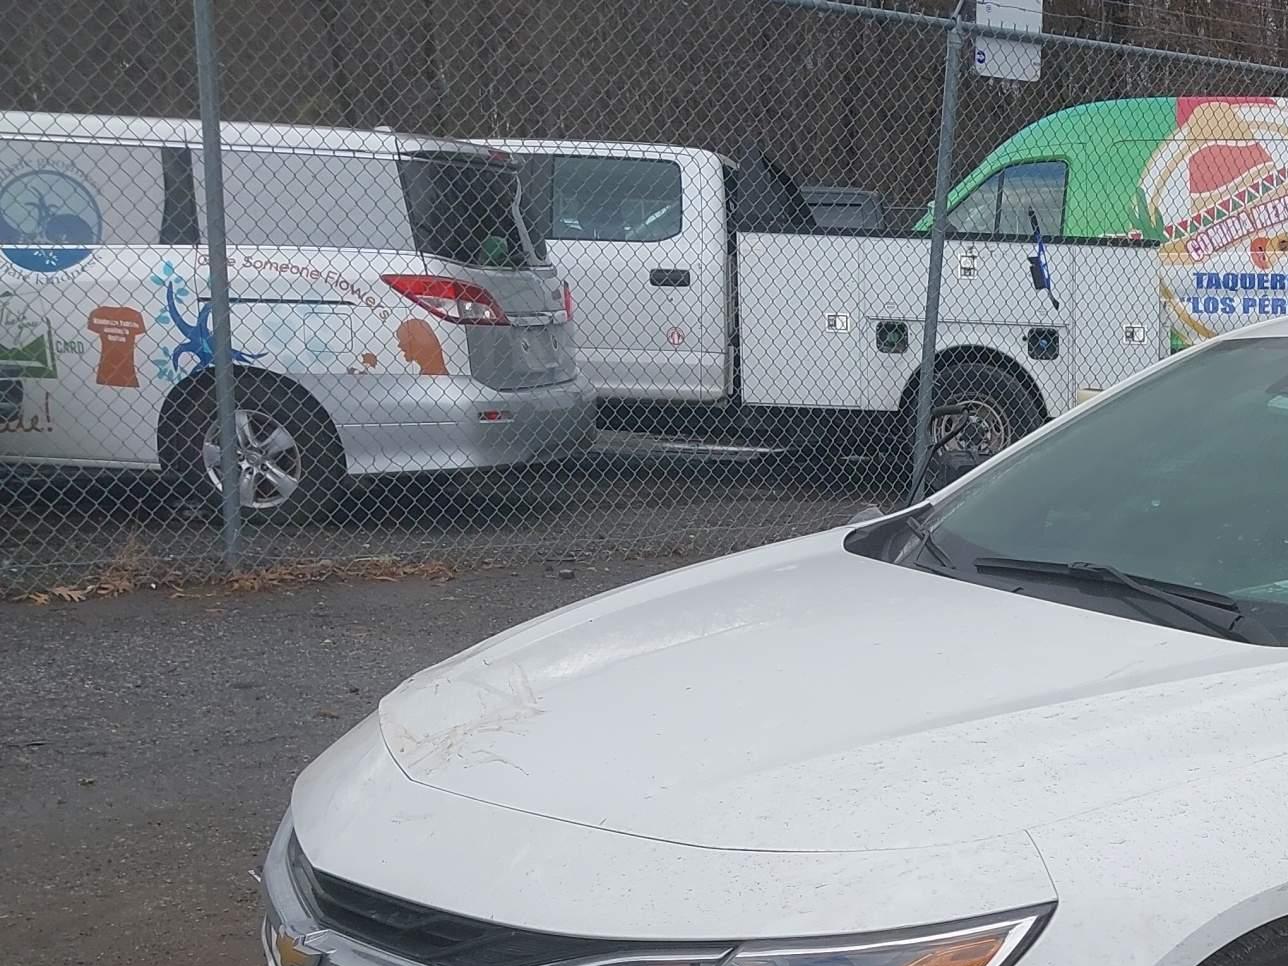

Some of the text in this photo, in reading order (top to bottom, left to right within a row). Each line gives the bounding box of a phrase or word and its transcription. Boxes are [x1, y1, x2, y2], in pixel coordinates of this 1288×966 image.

[1186, 211, 1256, 262] COMIDA
[242, 255, 322, 280] Someone
[324, 270, 392, 323] Flowers
